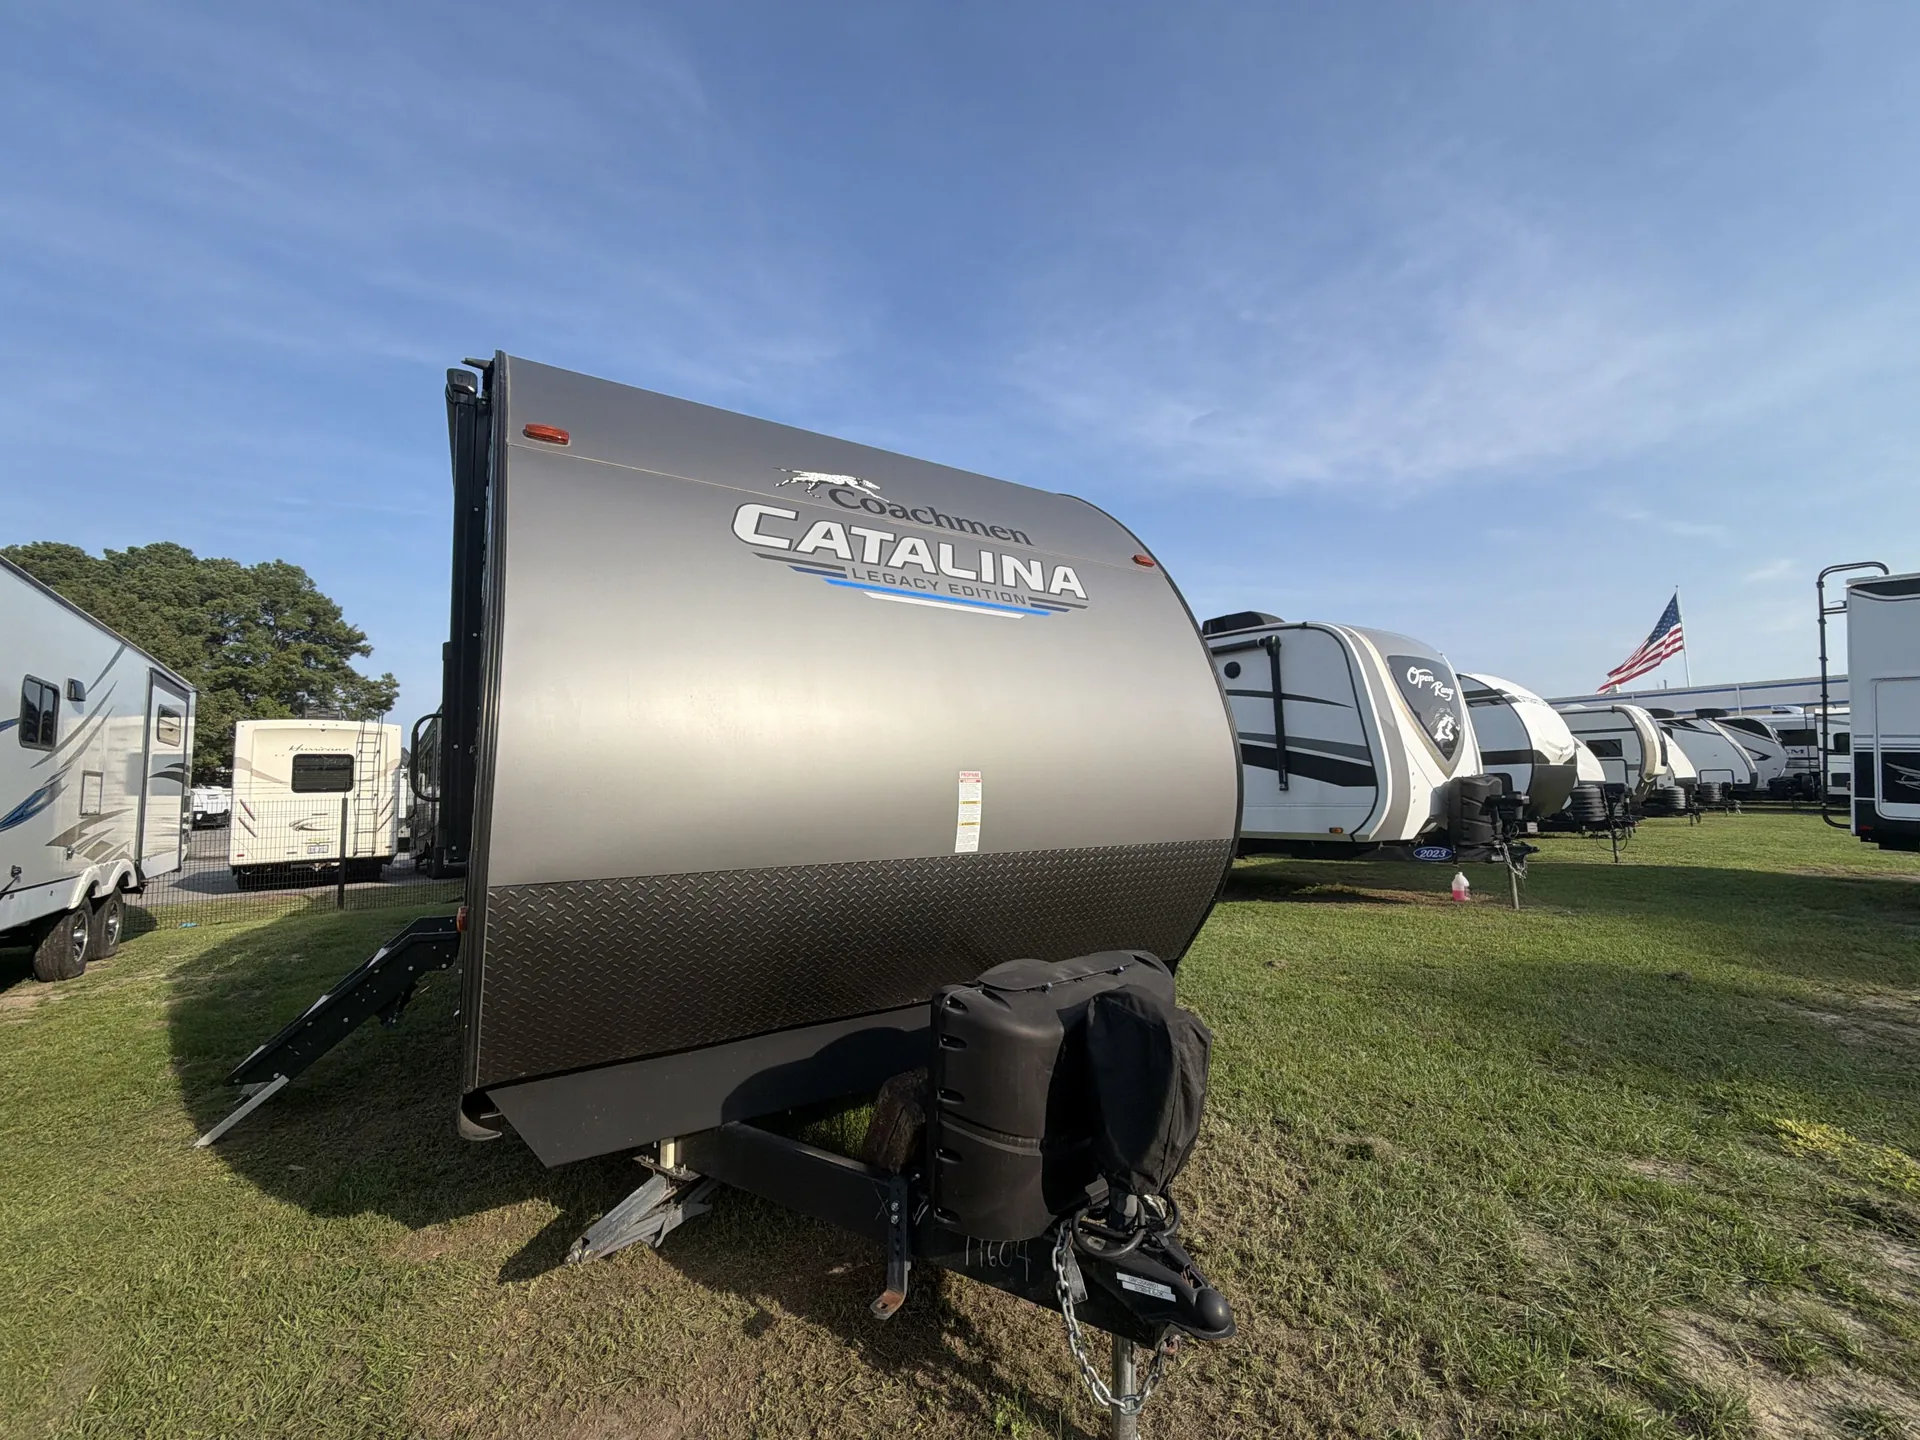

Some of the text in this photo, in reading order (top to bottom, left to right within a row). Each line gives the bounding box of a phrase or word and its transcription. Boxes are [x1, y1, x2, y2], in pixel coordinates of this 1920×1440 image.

[828, 488, 1035, 546] Coachmen
[731, 502, 1089, 600] CATALINA
[852, 568, 1027, 605] LEGACY EDITION
[1407, 666, 1434, 688] Open
[1420, 849, 1447, 858] 2023
